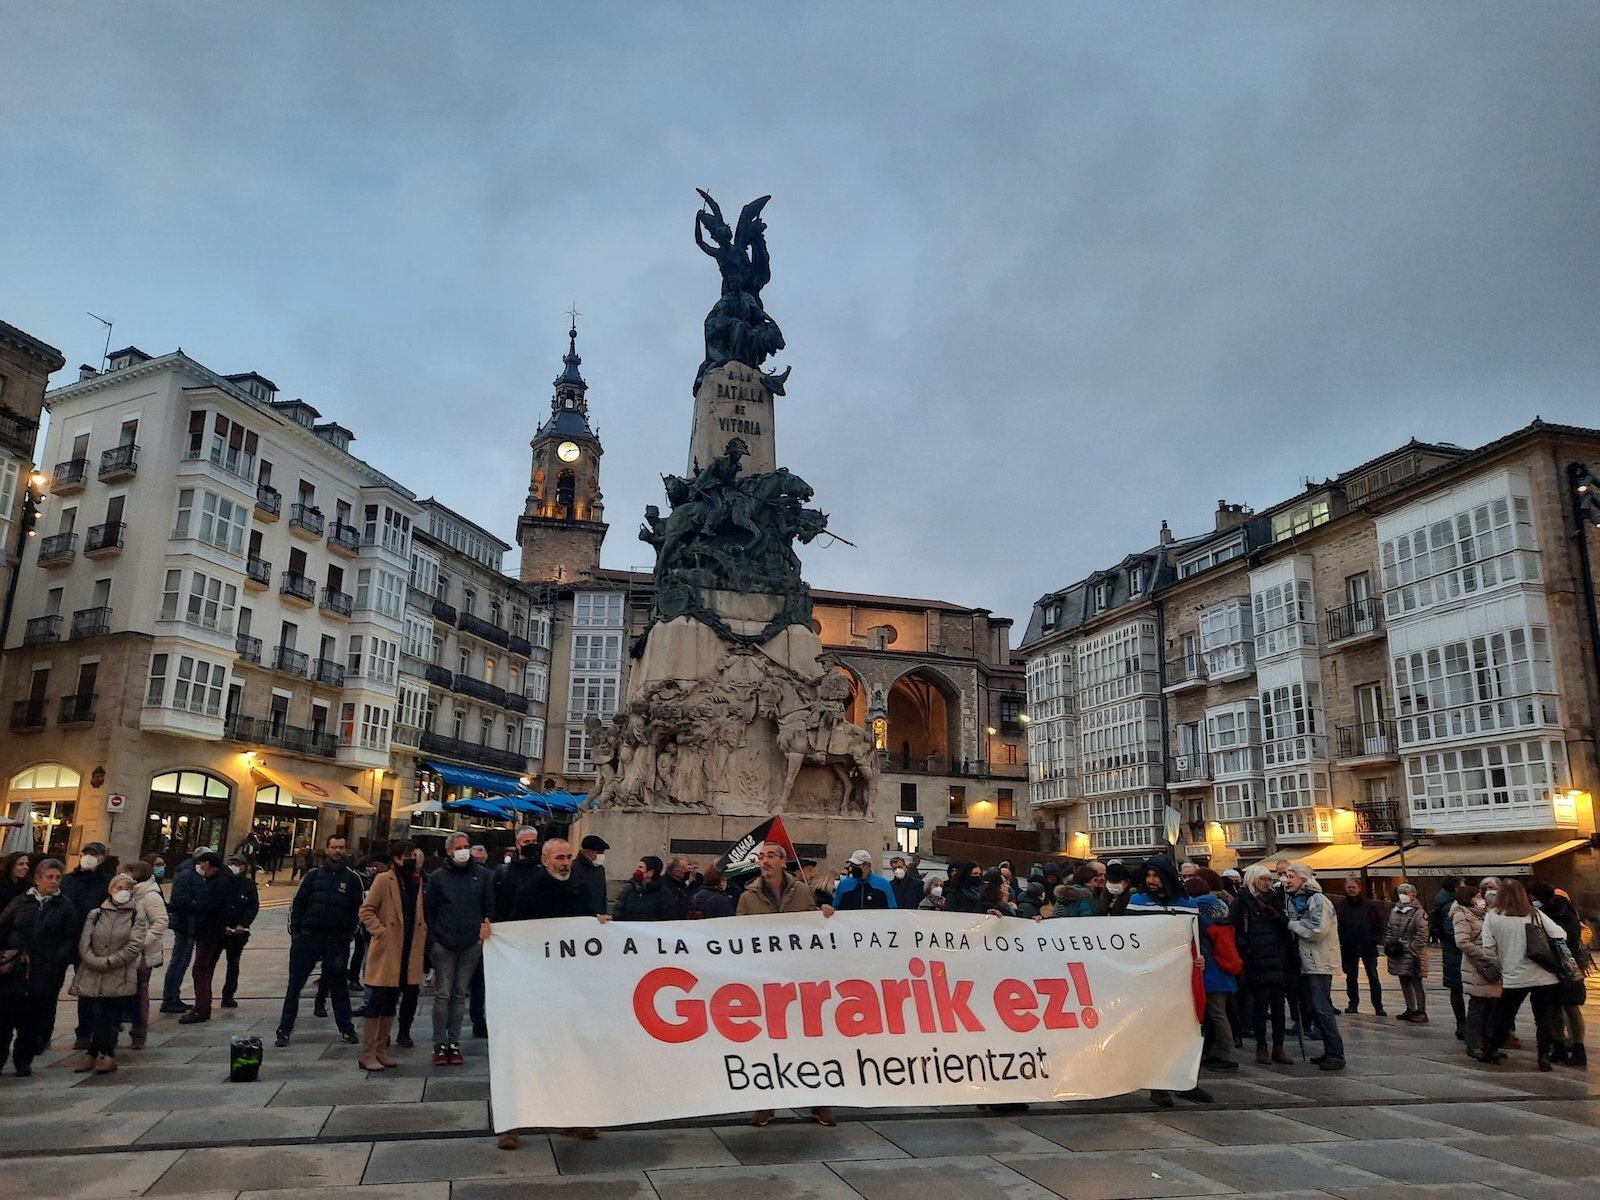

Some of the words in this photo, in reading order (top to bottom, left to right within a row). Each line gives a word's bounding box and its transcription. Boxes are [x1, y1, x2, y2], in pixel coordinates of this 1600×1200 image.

[719, 416, 761, 436] VITORIA
[623, 937, 638, 955] A
[657, 939, 690, 955] LA
[706, 932, 837, 955] GUERRA!
[853, 931, 899, 949] PAZ
[914, 931, 971, 950] PARA
[983, 936, 1025, 952] LOS
[1037, 933, 1141, 952] PUEBLOS
[632, 957, 986, 1044] Gerrarik
[993, 962, 1100, 1034] ez!
[723, 1052, 845, 1091] Bakea
[856, 1047, 1050, 1087] herrientzat
